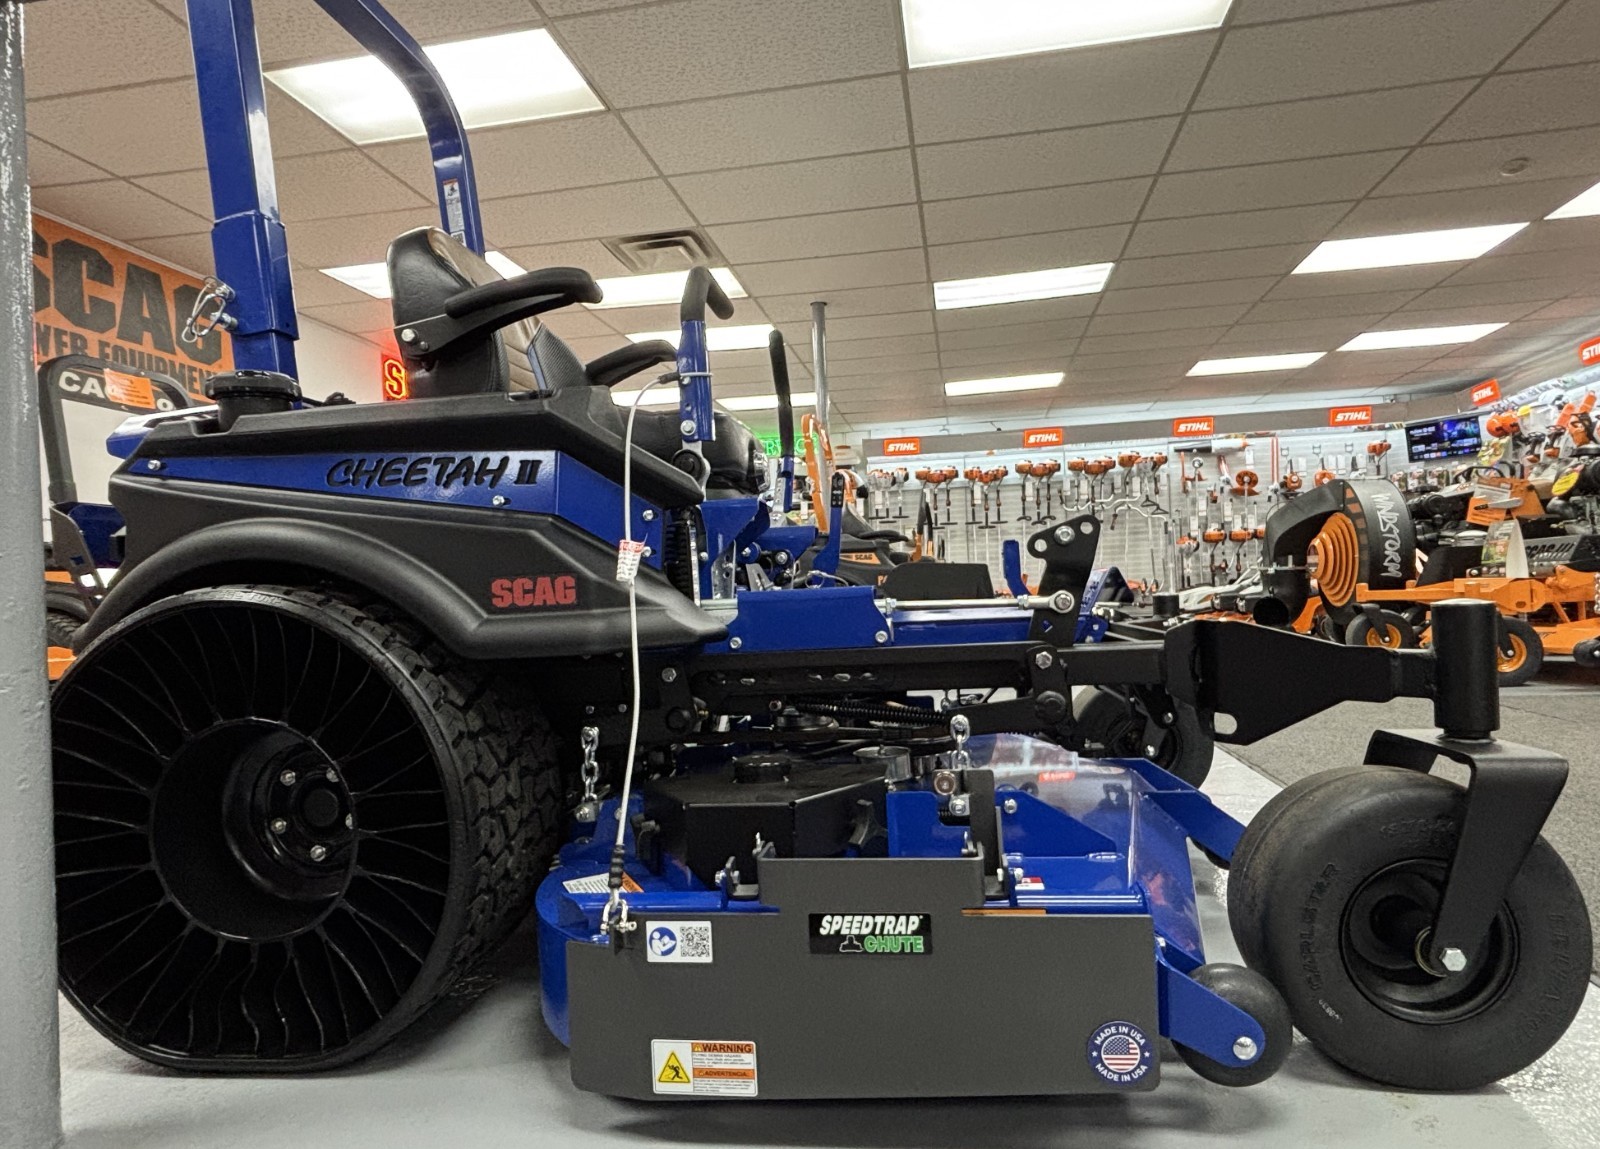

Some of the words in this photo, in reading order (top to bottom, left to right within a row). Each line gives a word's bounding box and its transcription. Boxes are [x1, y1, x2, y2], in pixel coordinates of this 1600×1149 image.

[1582, 343, 1600, 360] STI
[98, 340, 217, 395] EQUIPMEN
[1472, 386, 1494, 402] STIHL
[1335, 411, 1369, 421] STIHL
[1177, 421, 1210, 432] STIHL
[1028, 433, 1060, 443] STIHL
[887, 442, 917, 452] STIHL
[326, 456, 509, 490] CHEETAH
[514, 459, 542, 485] II
[1371, 493, 1402, 577] WINDSTORM
[491, 576, 576, 608] SCAG
[819, 915, 920, 935] SPEEDTRAP
[864, 936, 924, 953] CHUTE
[1094, 1026, 1117, 1045] MADE
[1130, 1029, 1146, 1046] USA
[702, 1043, 752, 1054] WARNING
[1095, 1063, 1119, 1081] MADE
[1132, 1064, 1148, 1079] USA
